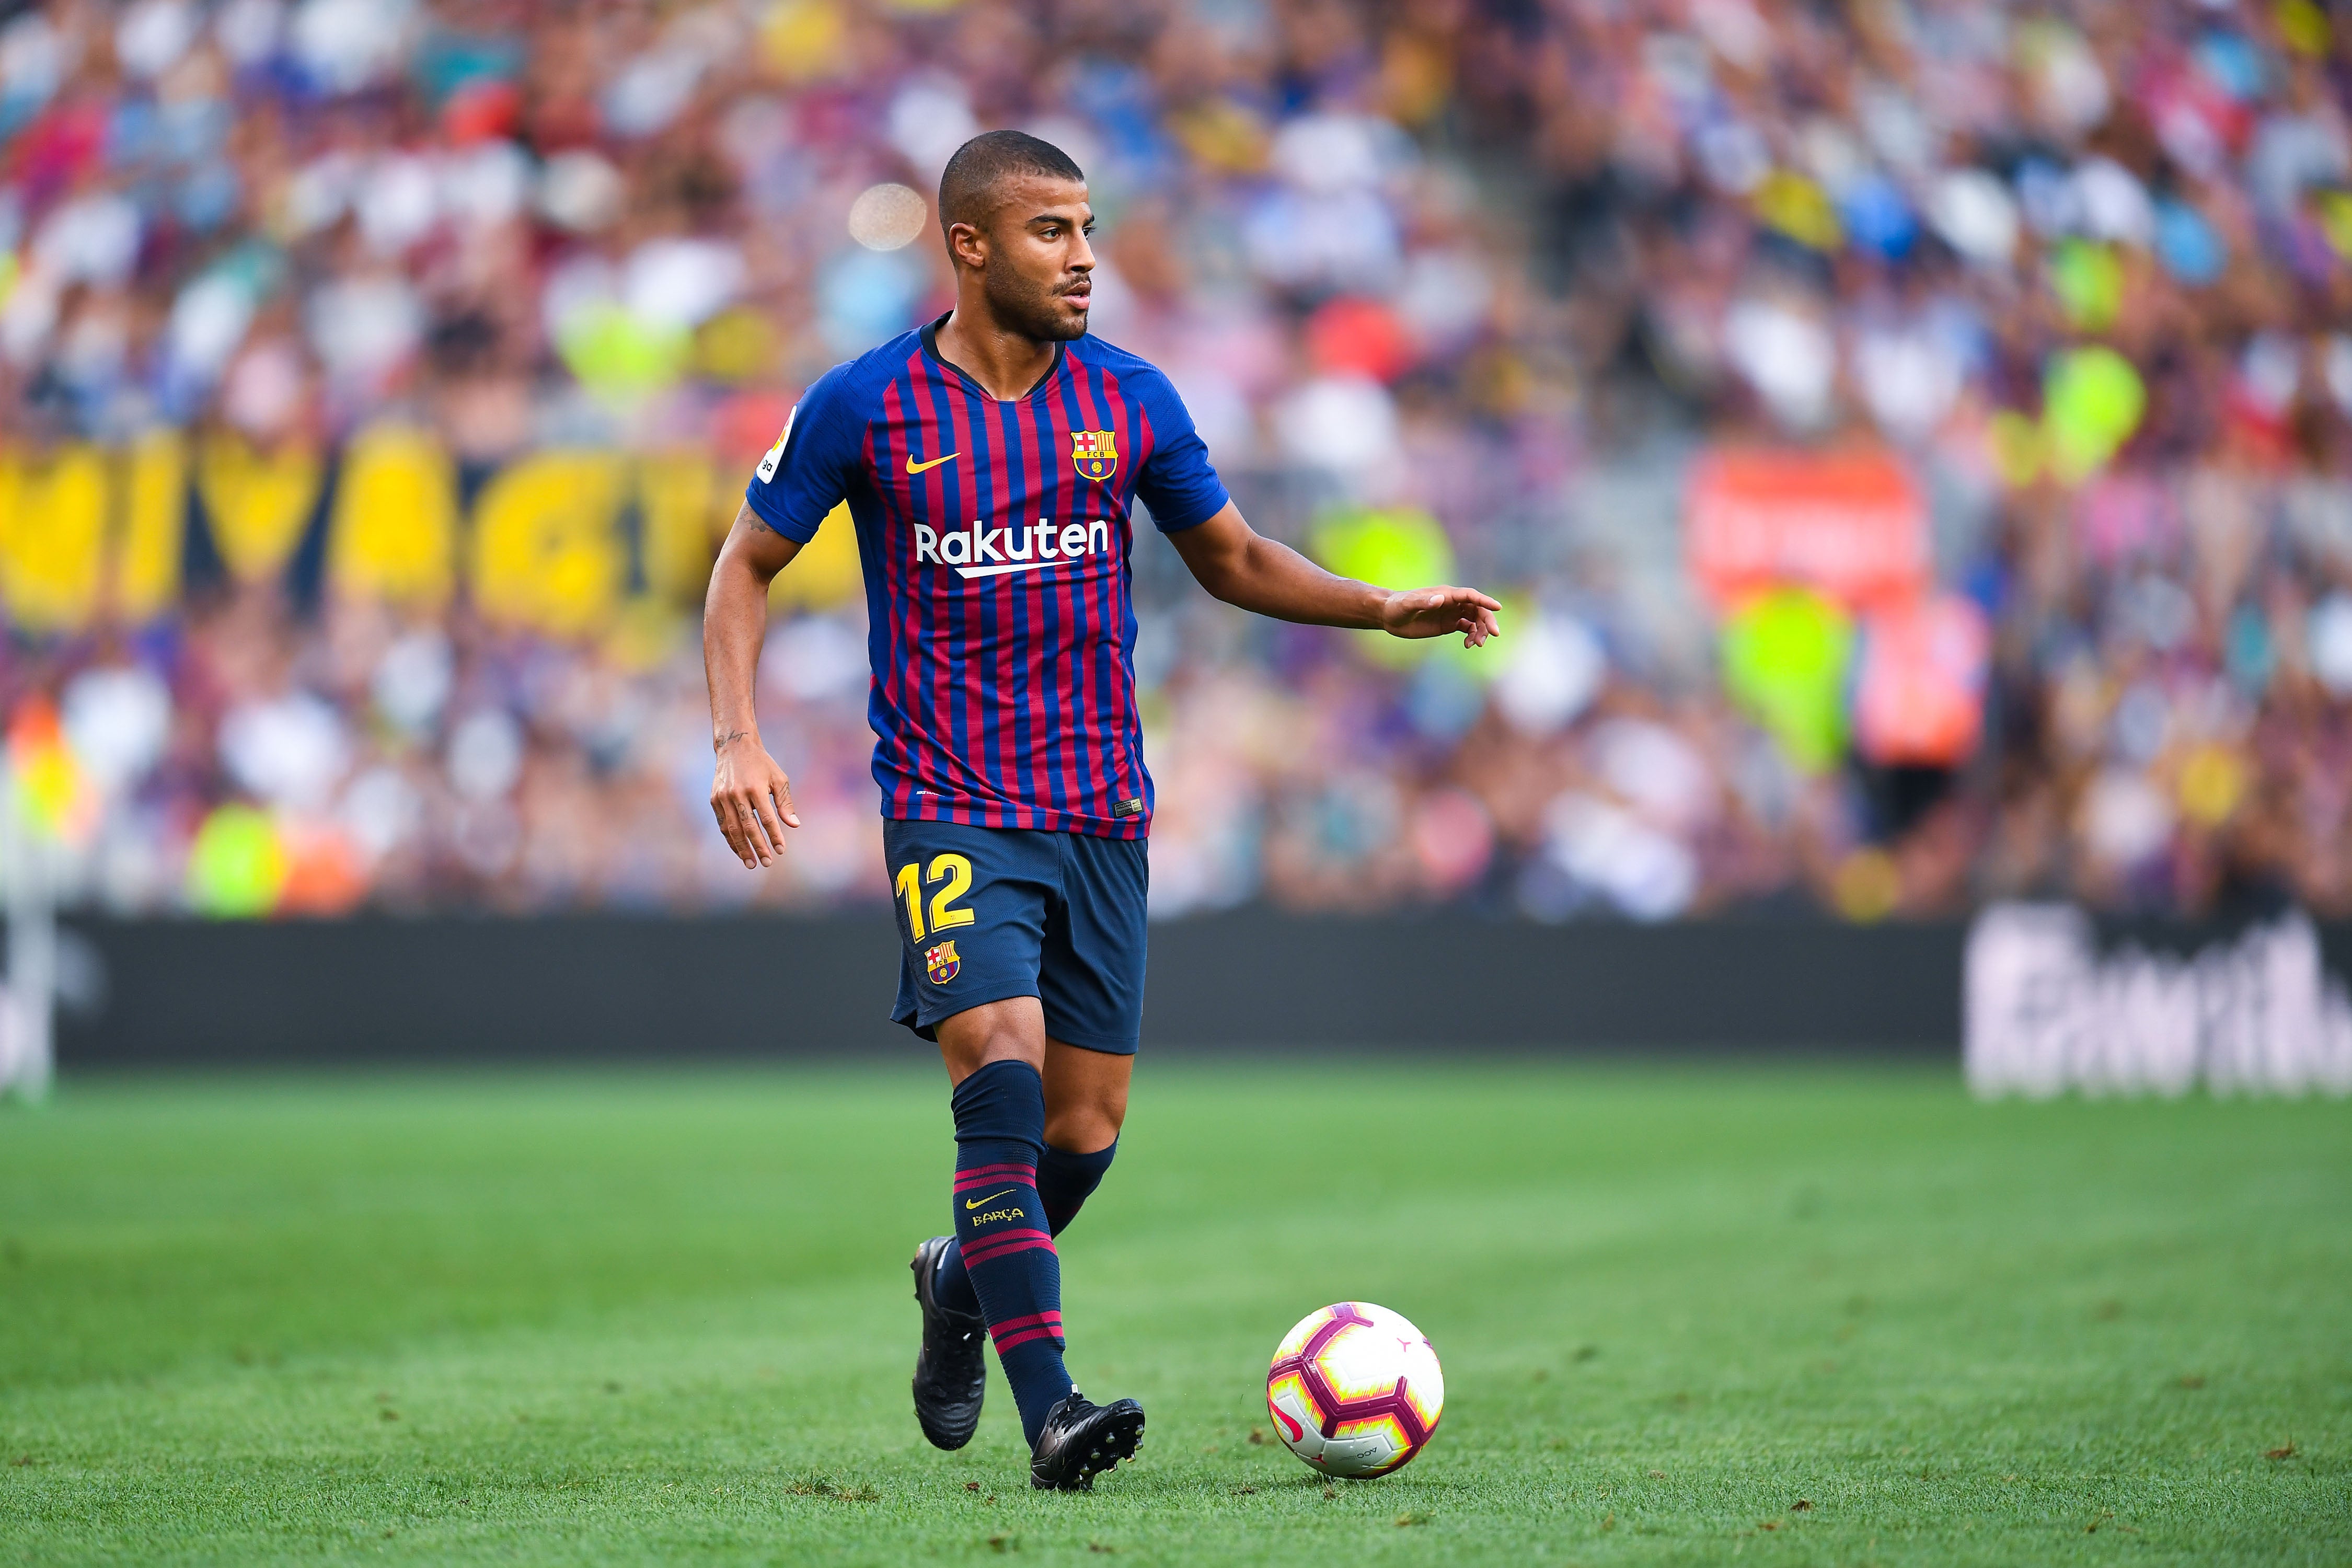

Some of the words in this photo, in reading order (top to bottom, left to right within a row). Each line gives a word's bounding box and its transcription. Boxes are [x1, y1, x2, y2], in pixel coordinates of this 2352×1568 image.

[914, 518, 1108, 564] Rakuten
[895, 854, 975, 944] 12
[935, 959, 948, 967] FCB
[972, 1208, 1024, 1227] BARÇA
